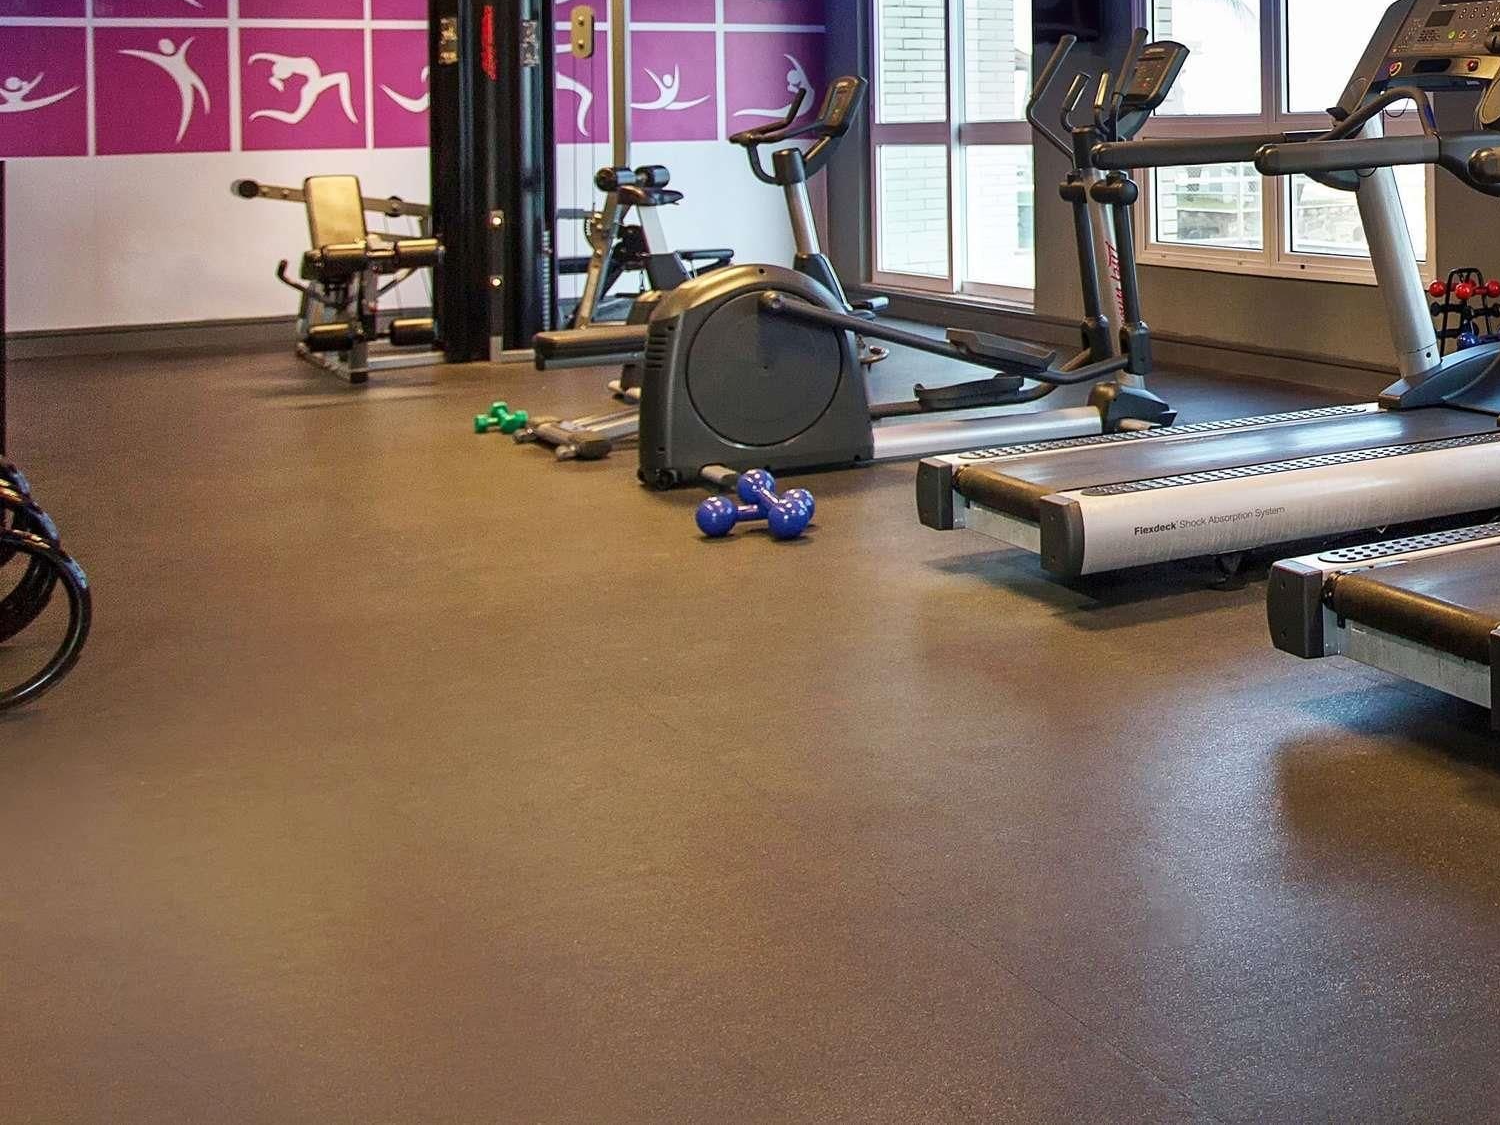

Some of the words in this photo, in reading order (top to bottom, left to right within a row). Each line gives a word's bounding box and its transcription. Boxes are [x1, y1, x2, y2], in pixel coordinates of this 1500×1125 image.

[1134, 523, 1177, 536] Flexdeck
[1179, 517, 1207, 529] Shock
[1208, 511, 1253, 524] Absorption
[1254, 506, 1286, 521] System
